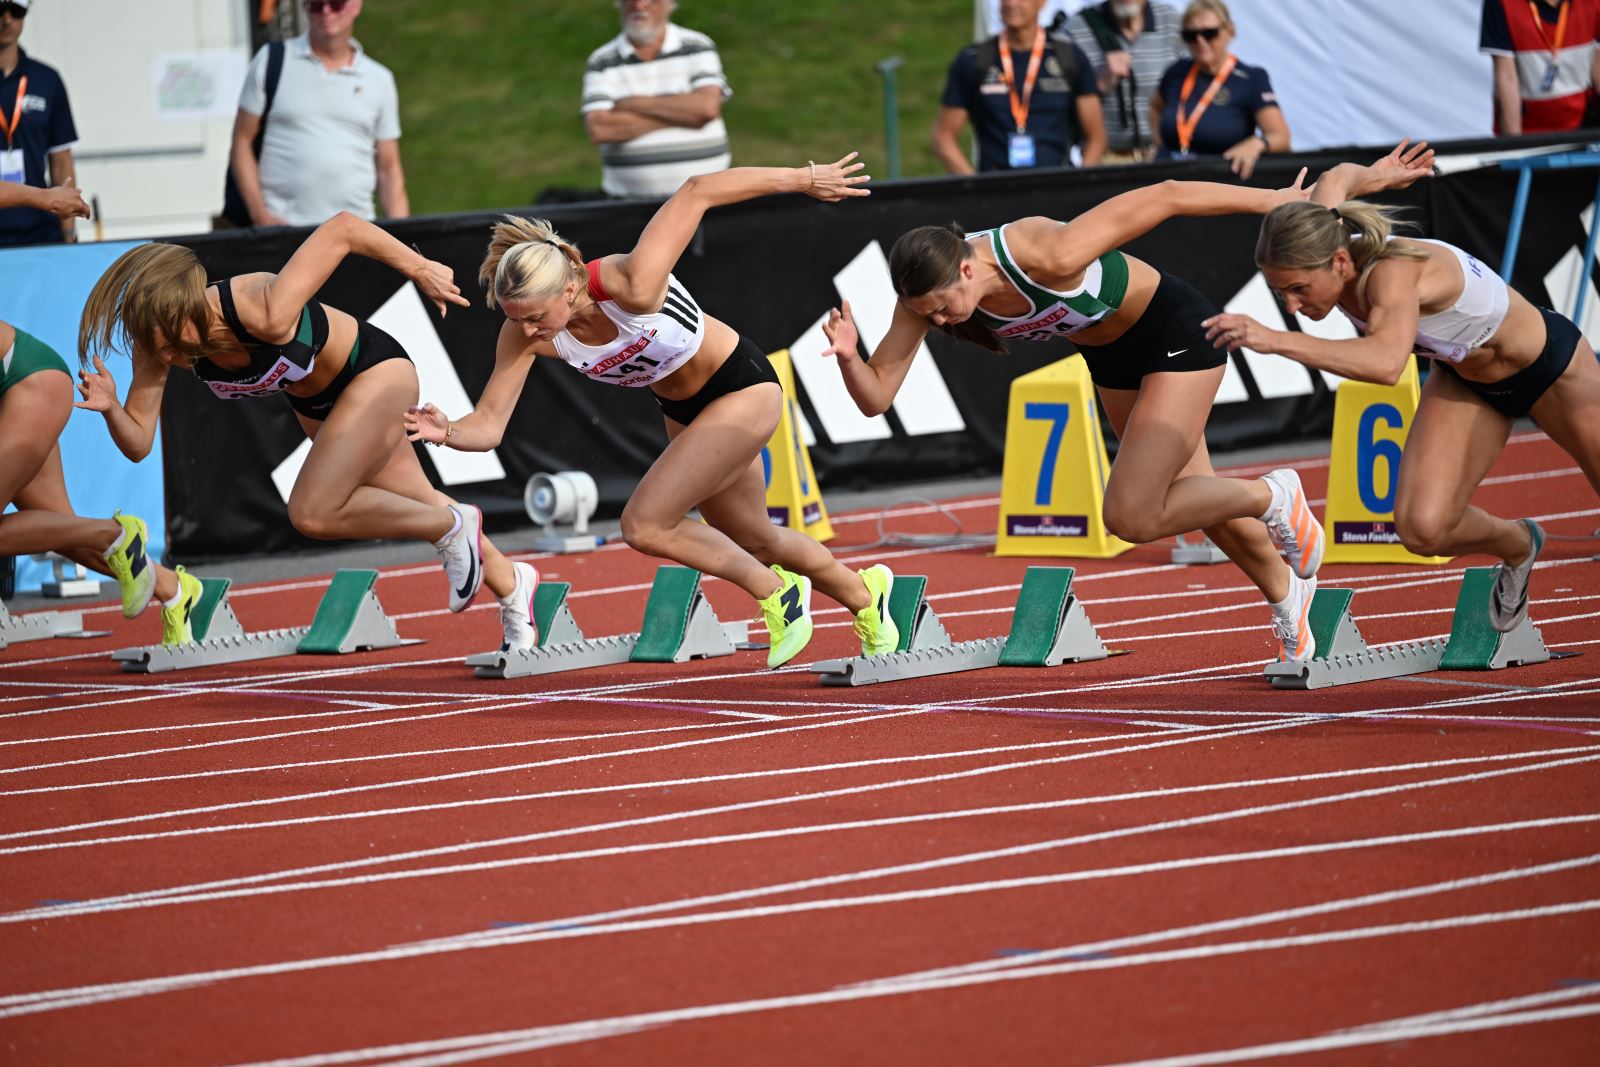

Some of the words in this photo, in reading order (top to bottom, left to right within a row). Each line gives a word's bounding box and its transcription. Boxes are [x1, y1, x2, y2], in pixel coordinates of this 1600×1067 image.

[1025, 402, 1070, 506] 7
[1357, 402, 1404, 515] 6
[1342, 531, 1366, 542] Stena
[1368, 531, 1402, 544] Fastigh
